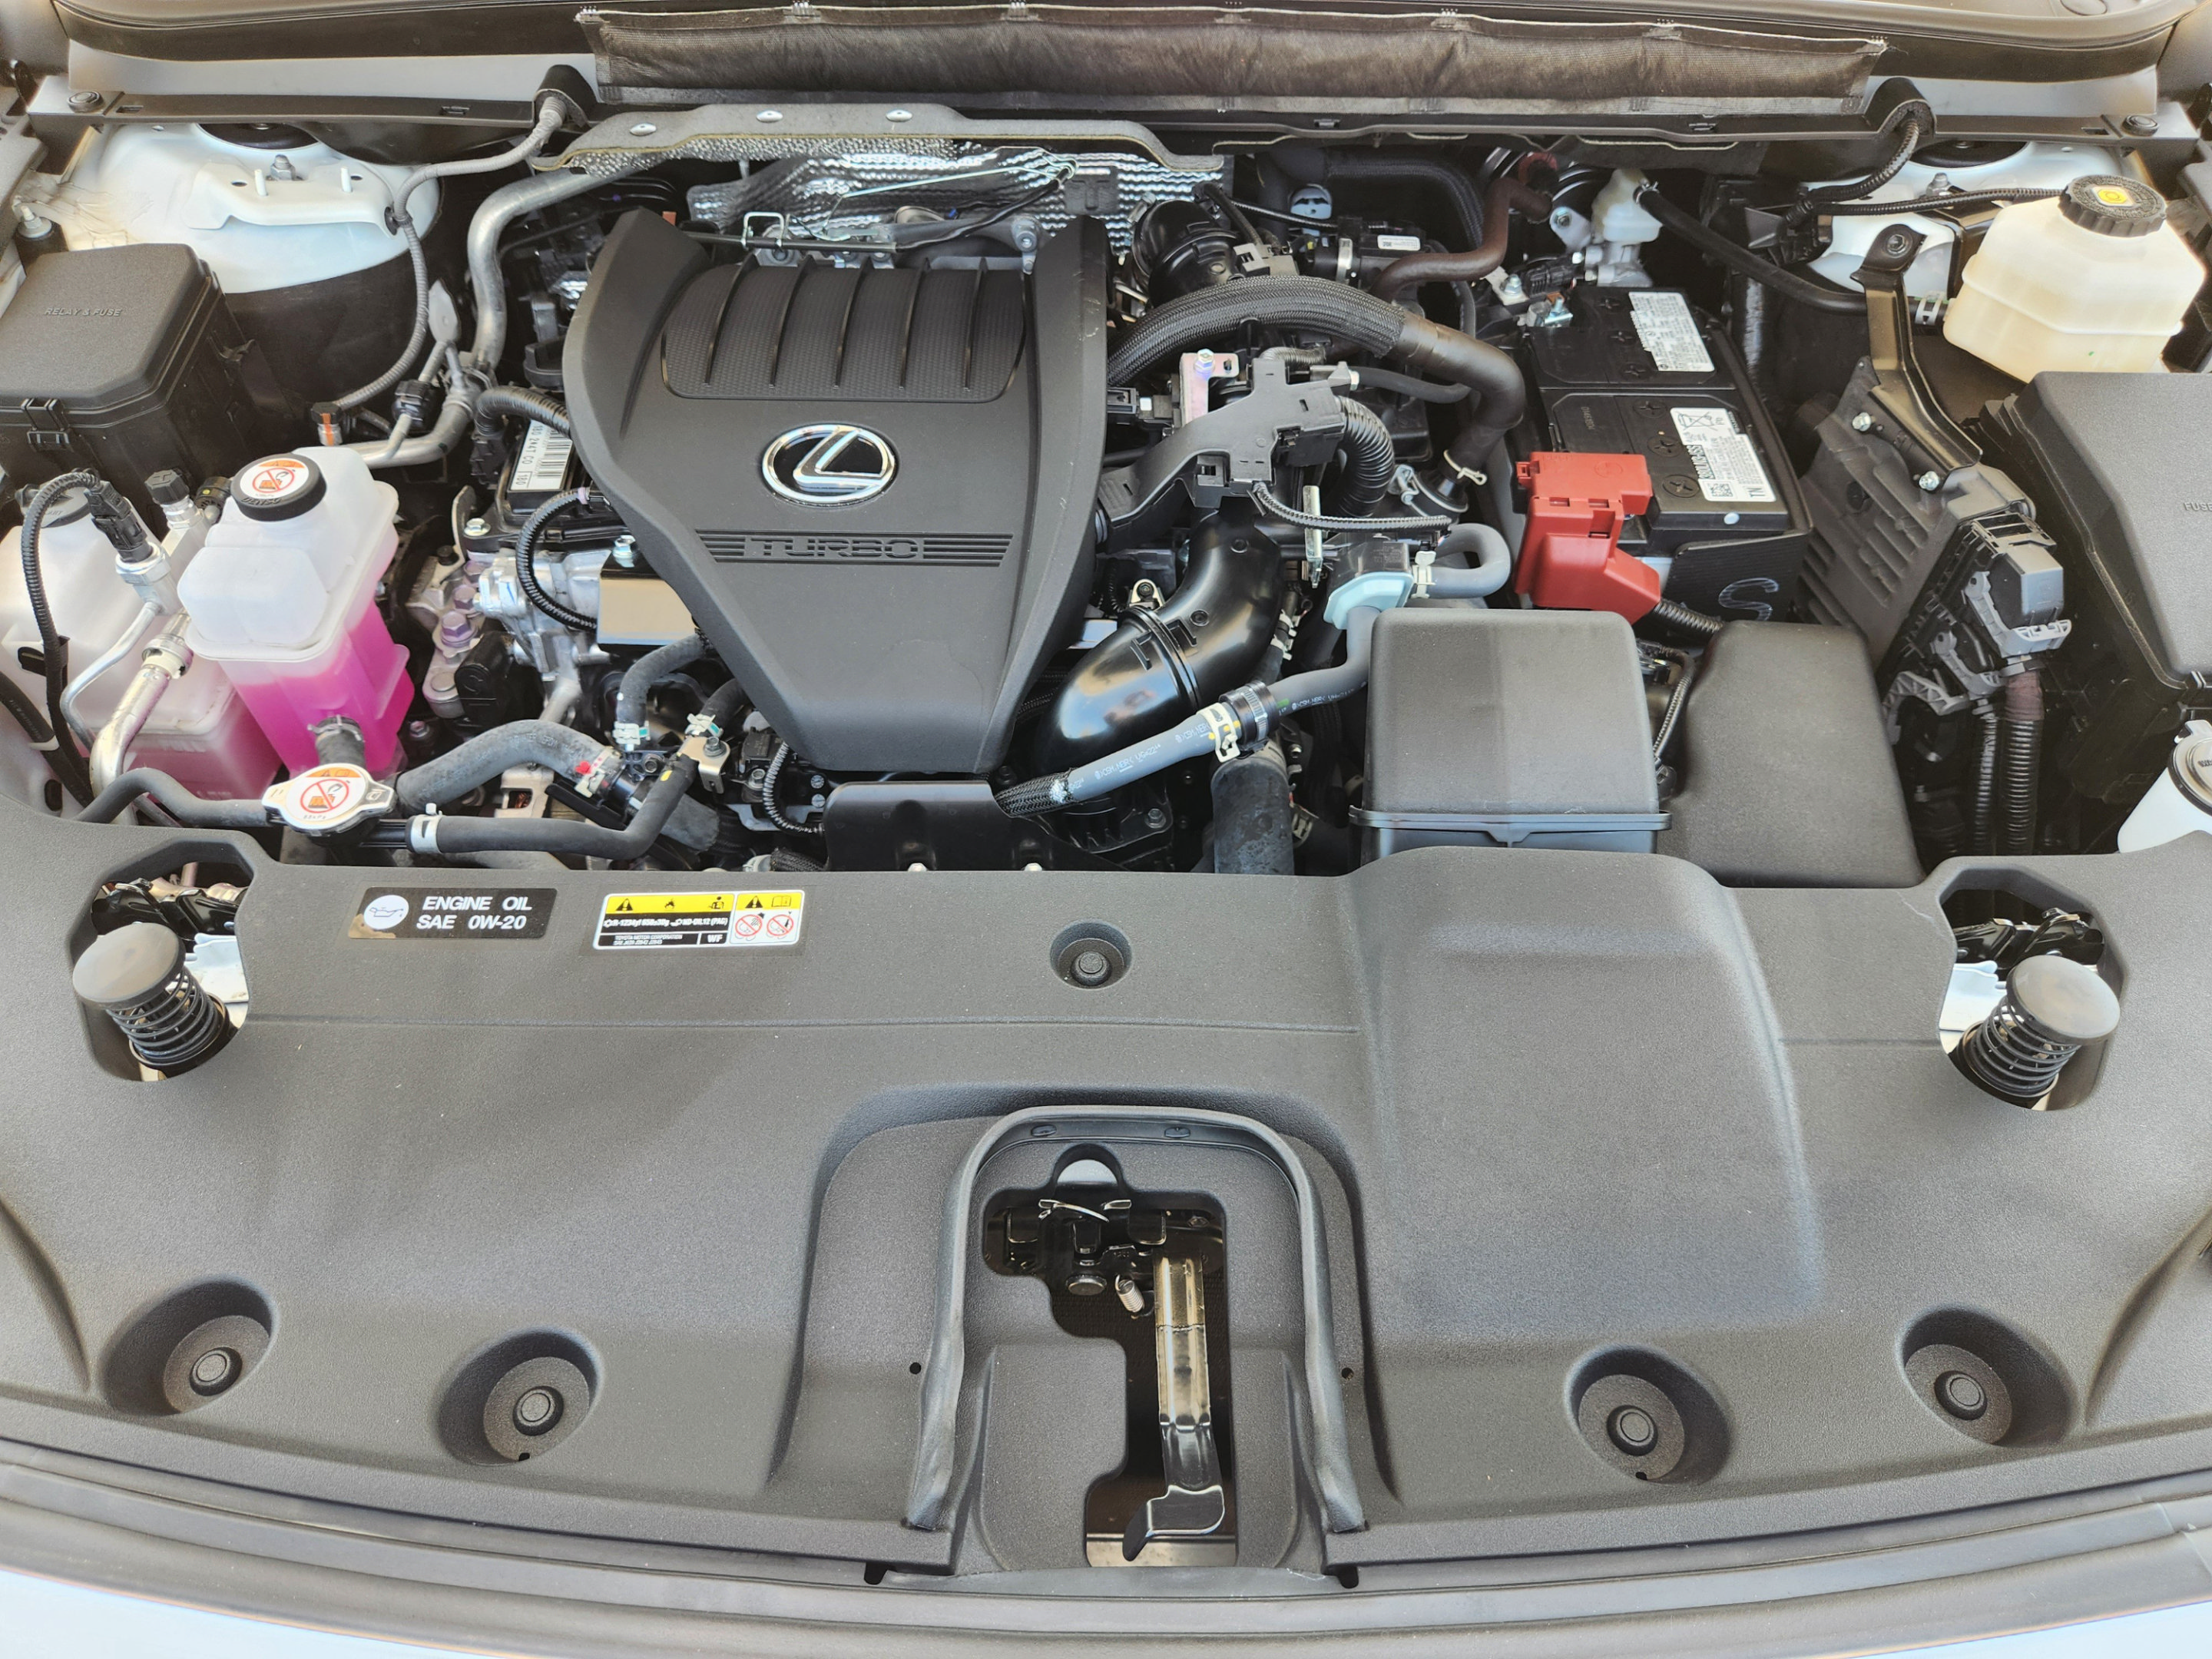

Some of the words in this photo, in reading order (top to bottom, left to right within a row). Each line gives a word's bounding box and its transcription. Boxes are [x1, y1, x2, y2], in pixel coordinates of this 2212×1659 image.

[92, 308, 122, 316] FUSE
[750, 538, 918, 558] TURBO
[422, 896, 493, 911] ENGINE
[502, 896, 533, 911] OIL
[416, 915, 458, 929] SAE
[468, 915, 527, 929] 0W-20
[710, 917, 728, 926] (PAG)
[707, 934, 724, 943] WF
